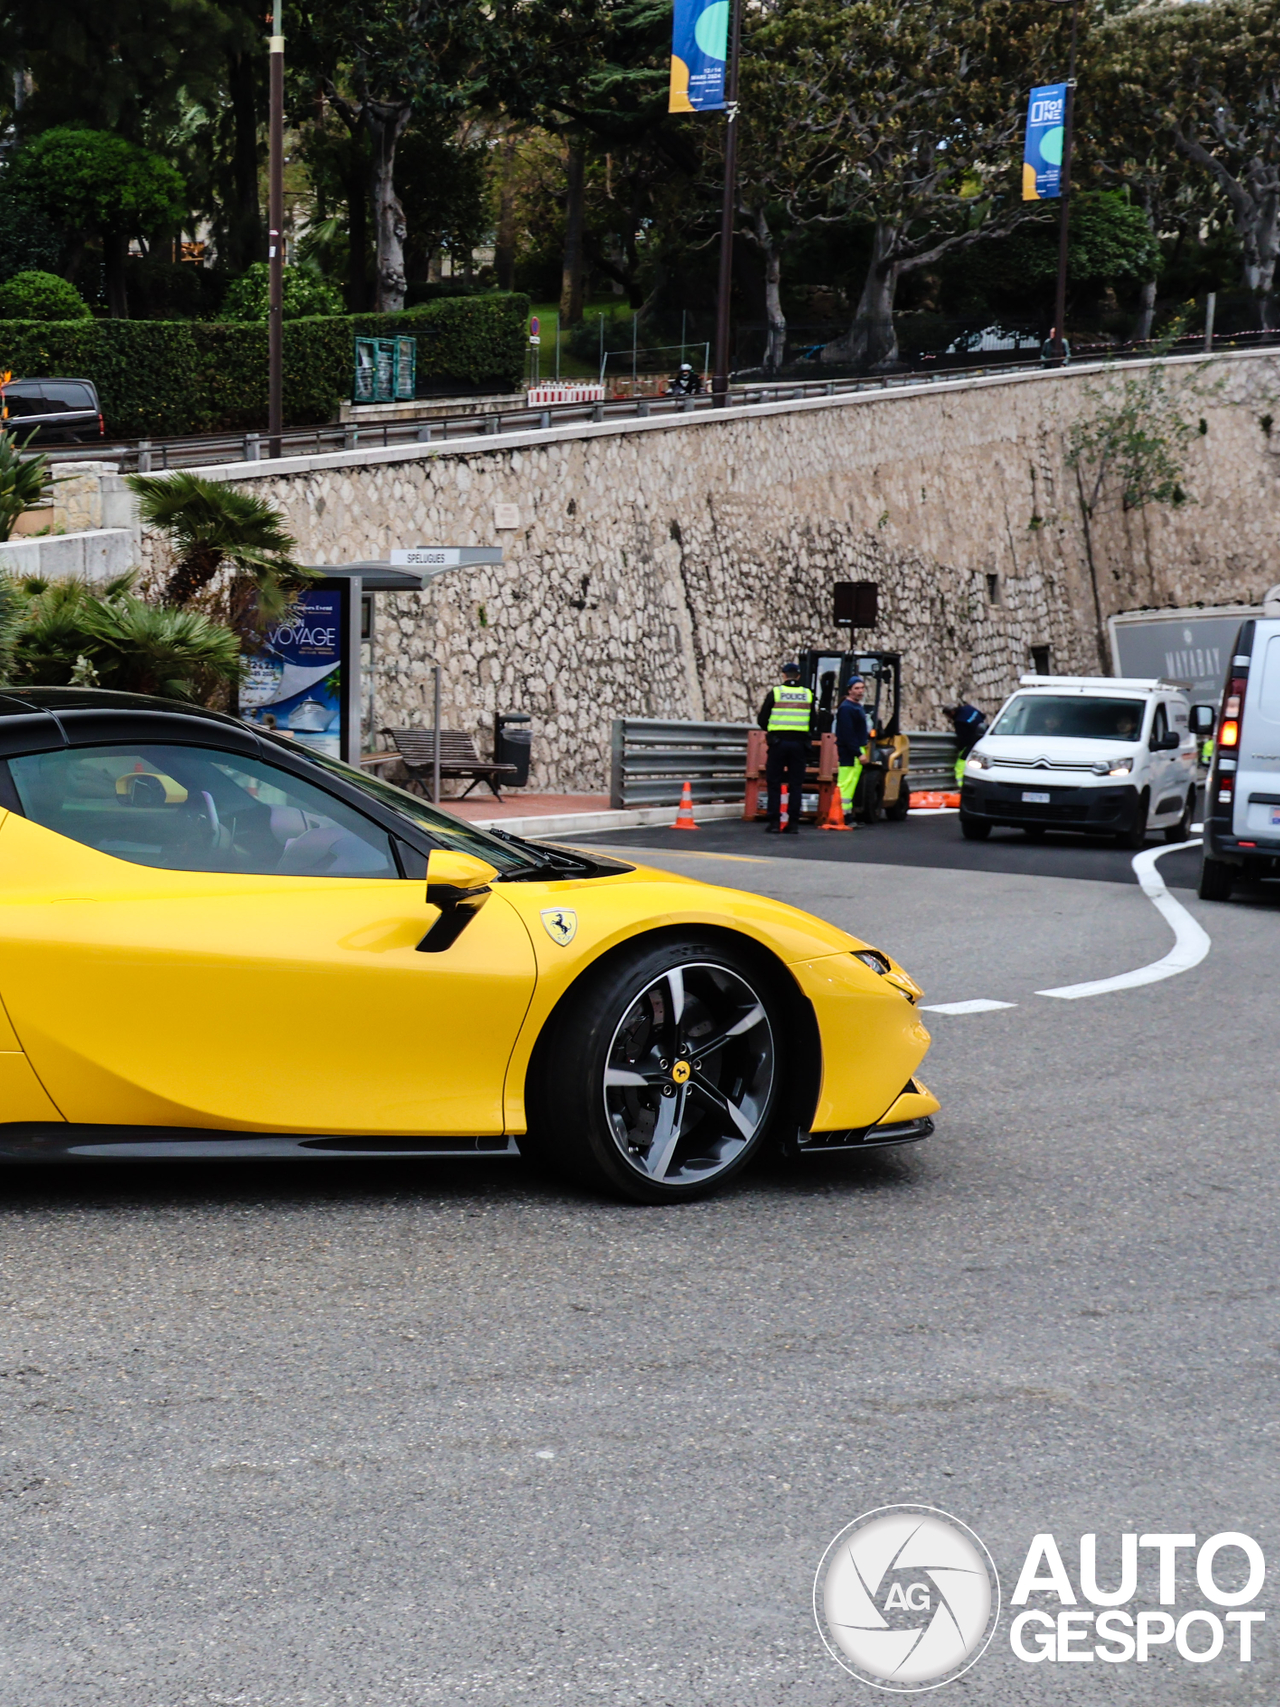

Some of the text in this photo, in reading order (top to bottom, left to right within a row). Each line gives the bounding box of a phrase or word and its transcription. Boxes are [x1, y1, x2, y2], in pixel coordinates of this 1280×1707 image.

[407, 551, 446, 563] SPÉLUGUES
[268, 627, 336, 646] VOYAGE
[780, 692, 807, 700] POLICE
